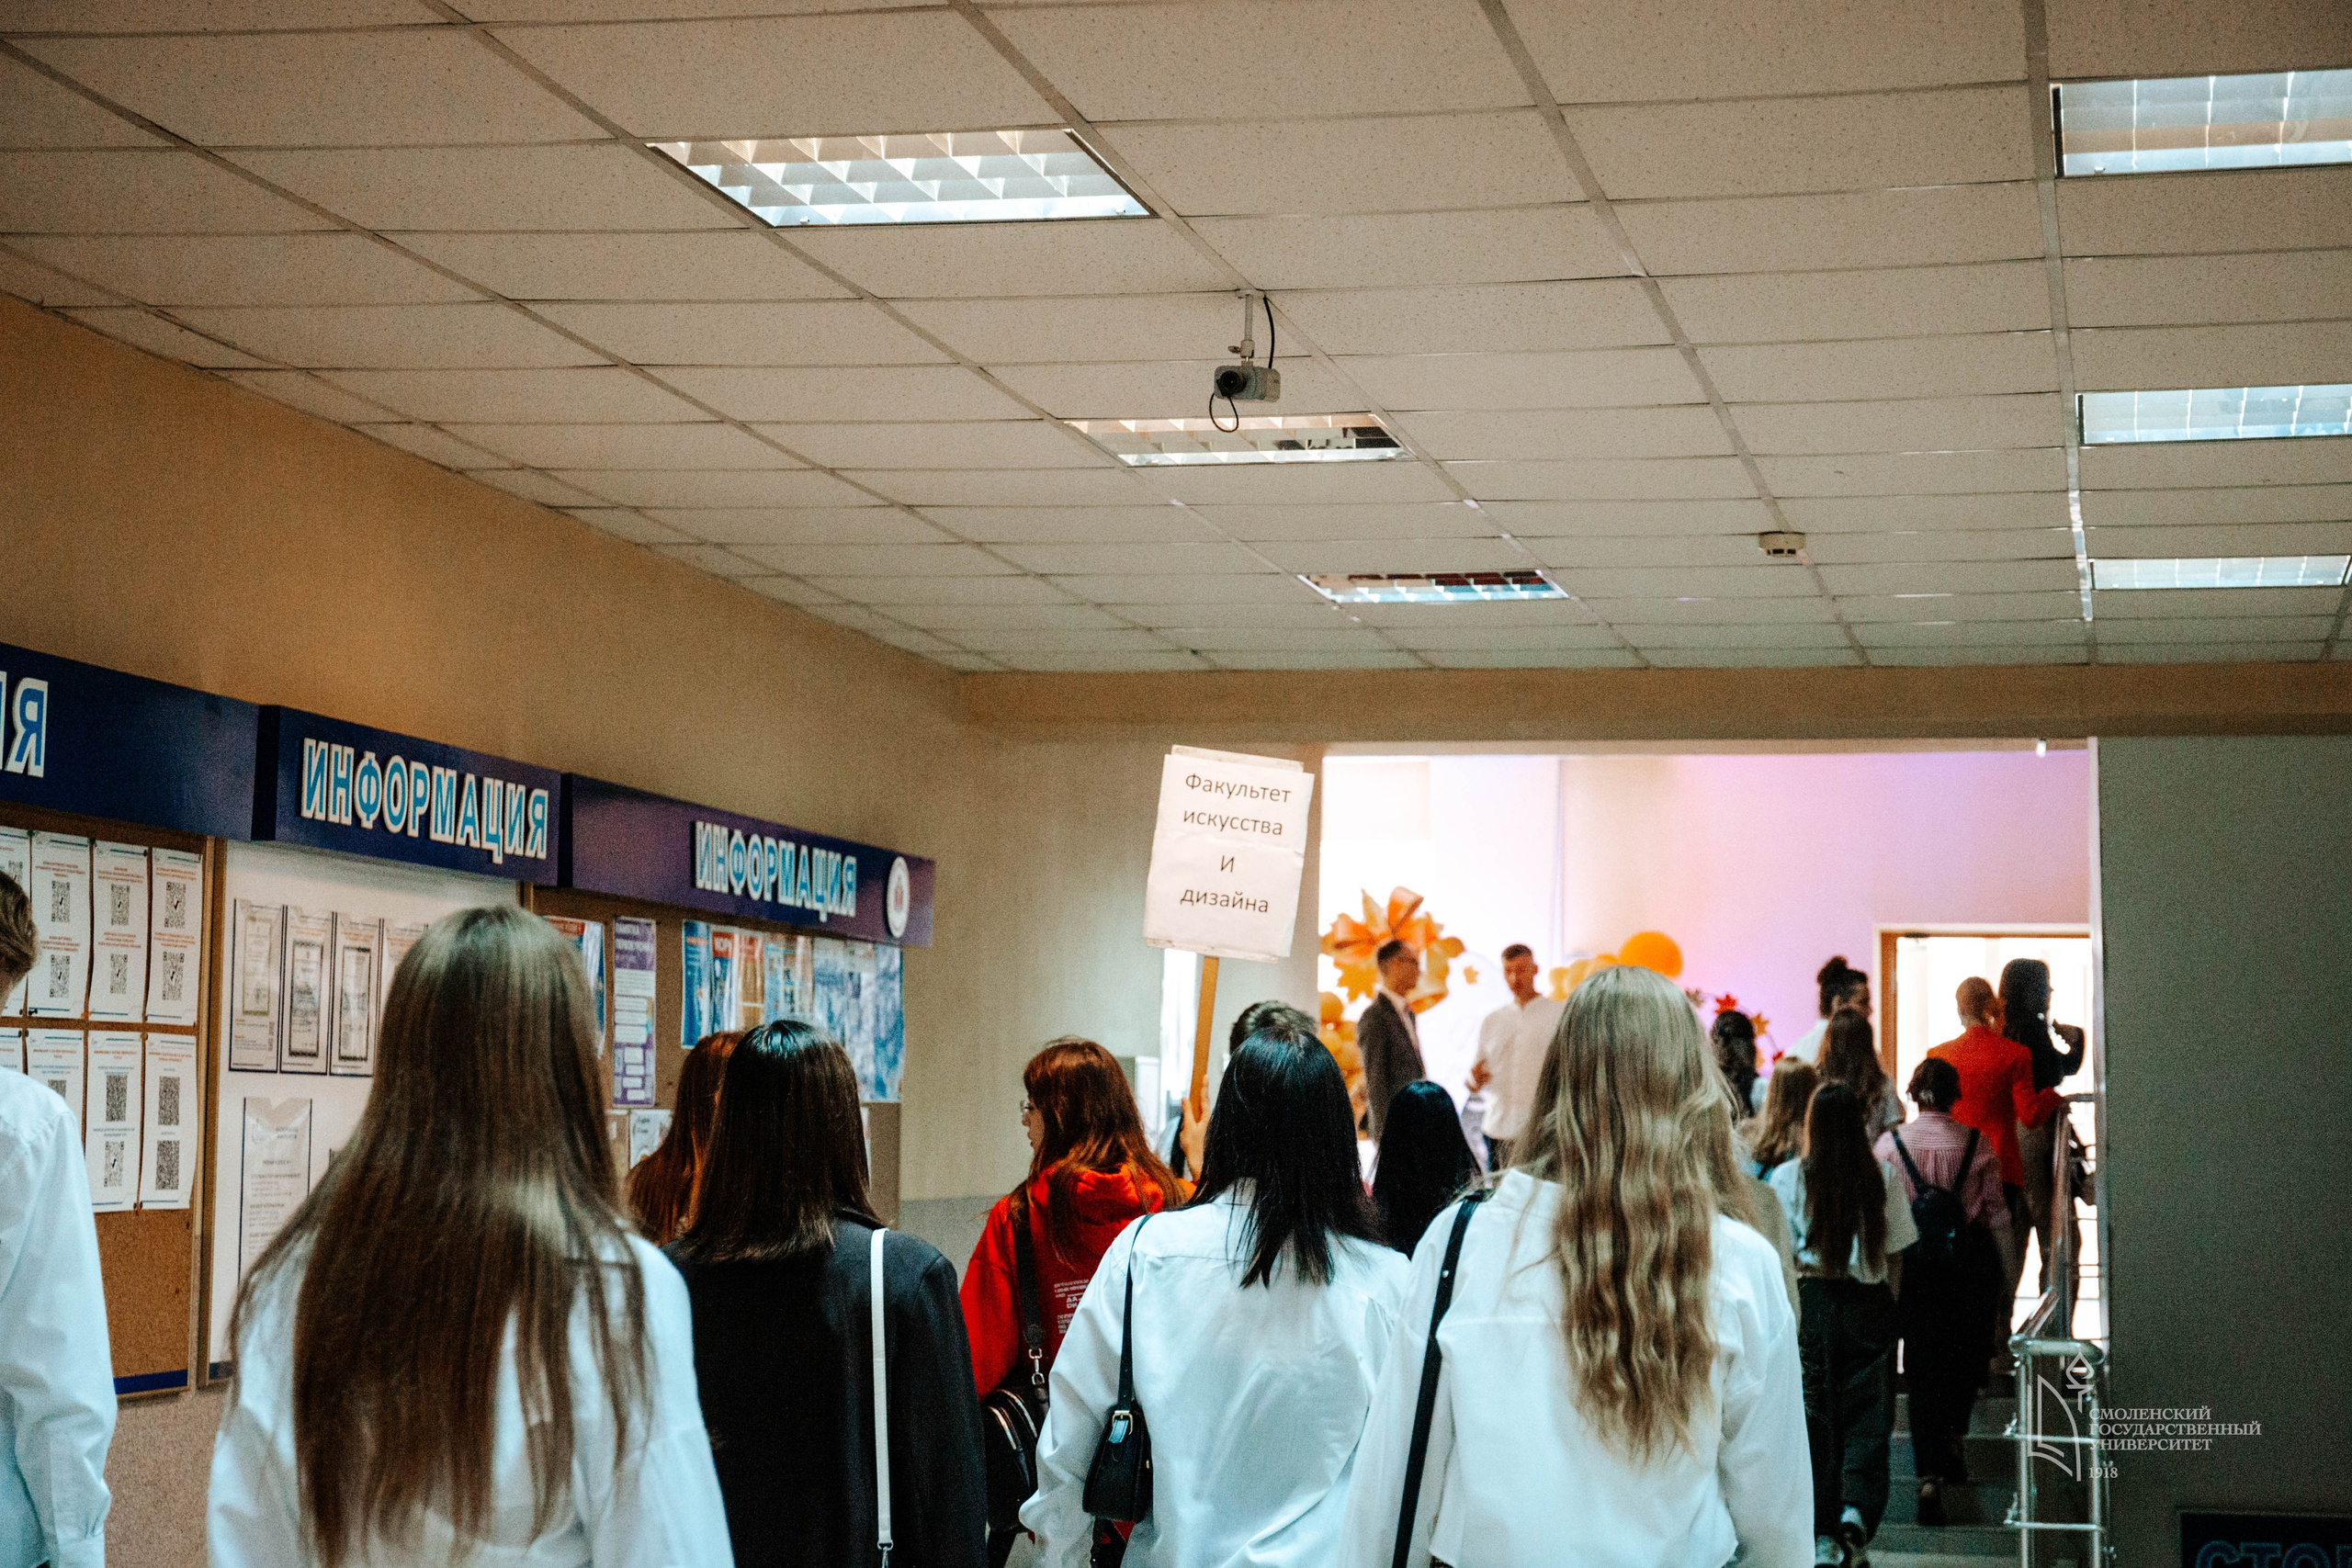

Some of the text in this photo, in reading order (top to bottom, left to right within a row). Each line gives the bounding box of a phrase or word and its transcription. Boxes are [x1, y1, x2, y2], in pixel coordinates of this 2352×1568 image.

[300, 738, 549, 864] ИНФОРМАЦИЯ
[1185, 773, 1292, 803] Факультет
[1183, 809, 1283, 837] искусства
[694, 820, 858, 924] ИНФОРМАЦИЯ
[1180, 888, 1270, 913] дизайна
